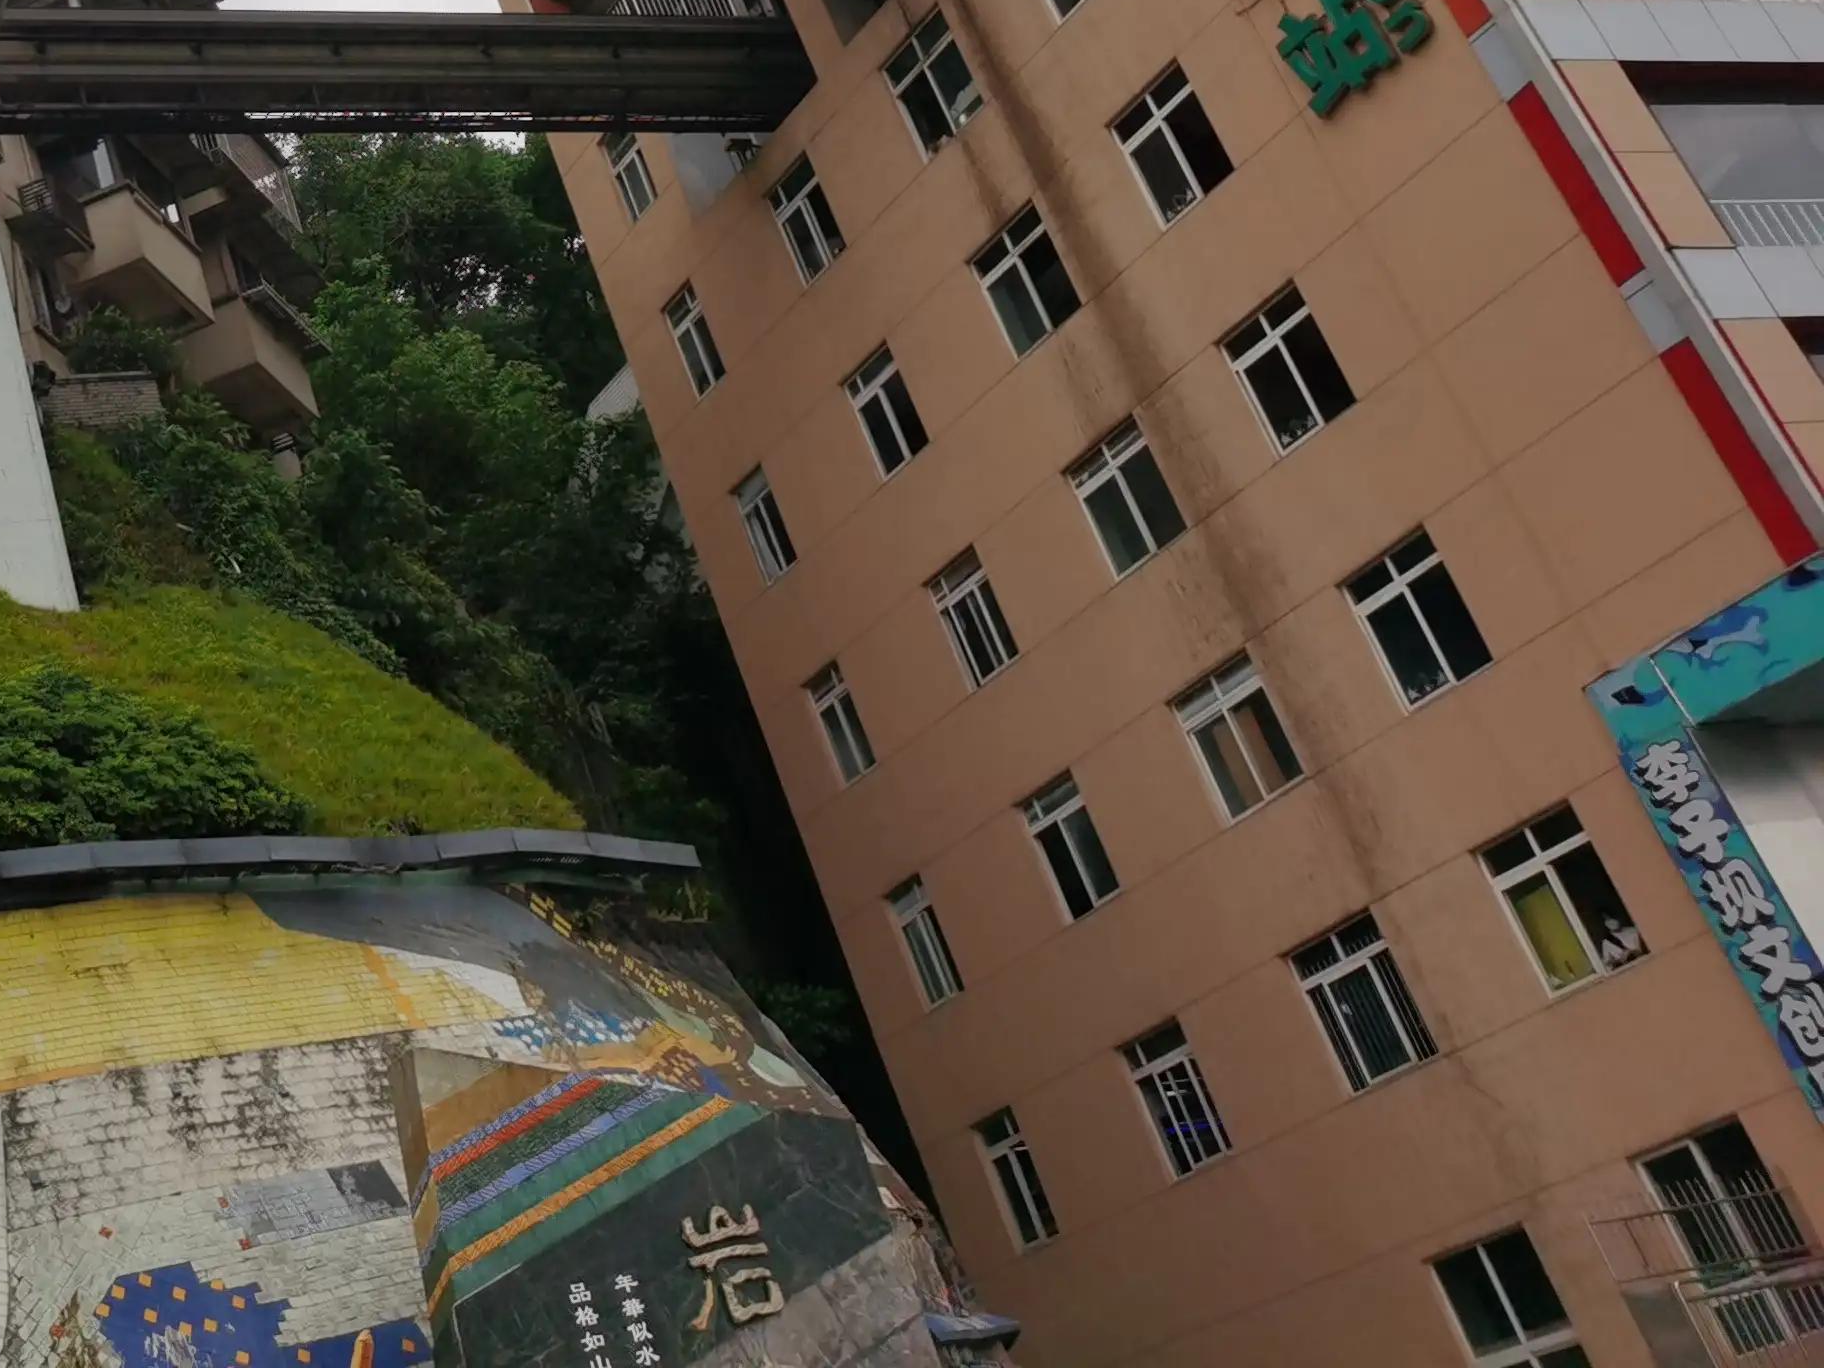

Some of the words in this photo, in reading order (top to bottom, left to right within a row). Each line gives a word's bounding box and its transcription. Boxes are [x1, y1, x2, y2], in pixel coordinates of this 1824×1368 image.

[1635, 739, 1824, 1097] 李子坝文创
[681, 1203, 784, 1330] 岩
